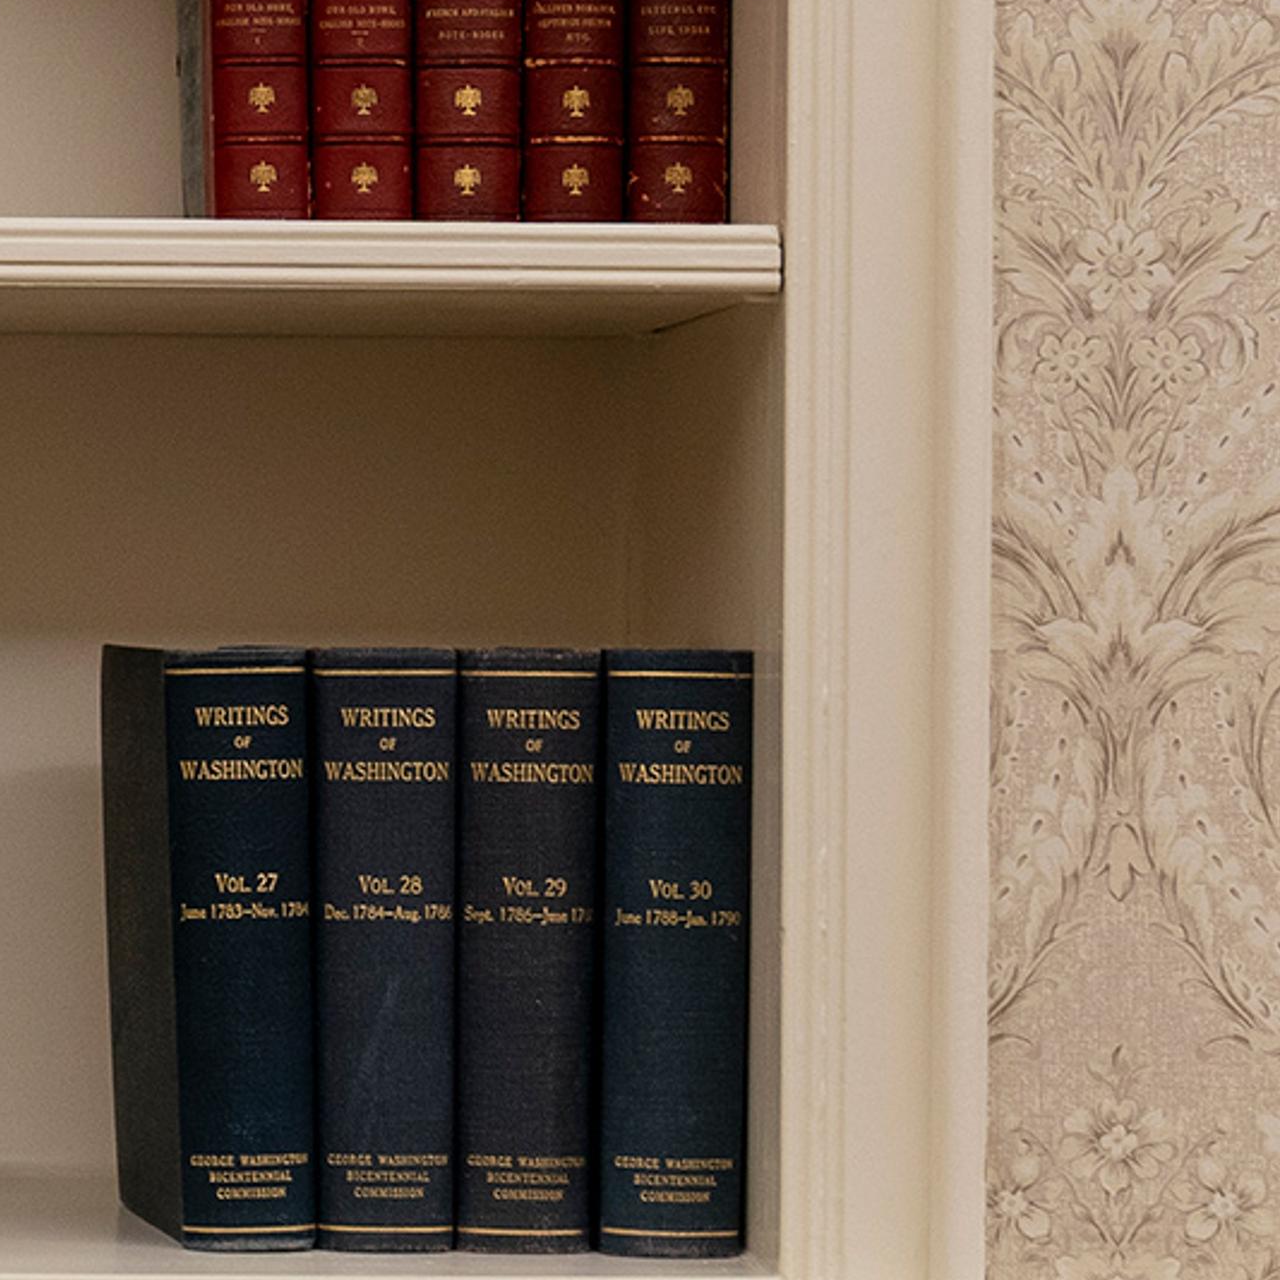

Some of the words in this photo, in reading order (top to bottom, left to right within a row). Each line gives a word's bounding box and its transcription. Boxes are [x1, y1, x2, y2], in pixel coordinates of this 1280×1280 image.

[194, 704, 290, 727] WRITINGS
[340, 707, 436, 728] WRITINGS
[486, 708, 581, 730] WRITINGS
[635, 709, 730, 731] WRITINGS
[233, 735, 252, 749] OF
[378, 737, 397, 751] OF
[525, 738, 543, 753] OF
[674, 739, 692, 754] OF
[179, 758, 303, 781] WASHINGTON
[324, 761, 449, 782] WASHINGTON
[470, 761, 593, 784] WASHINGTON
[618, 762, 742, 785] WASHINGTON
[256, 872, 279, 893] 27
[399, 874, 424, 895] 28
[544, 877, 568, 898] 29
[689, 879, 713, 901] 30
